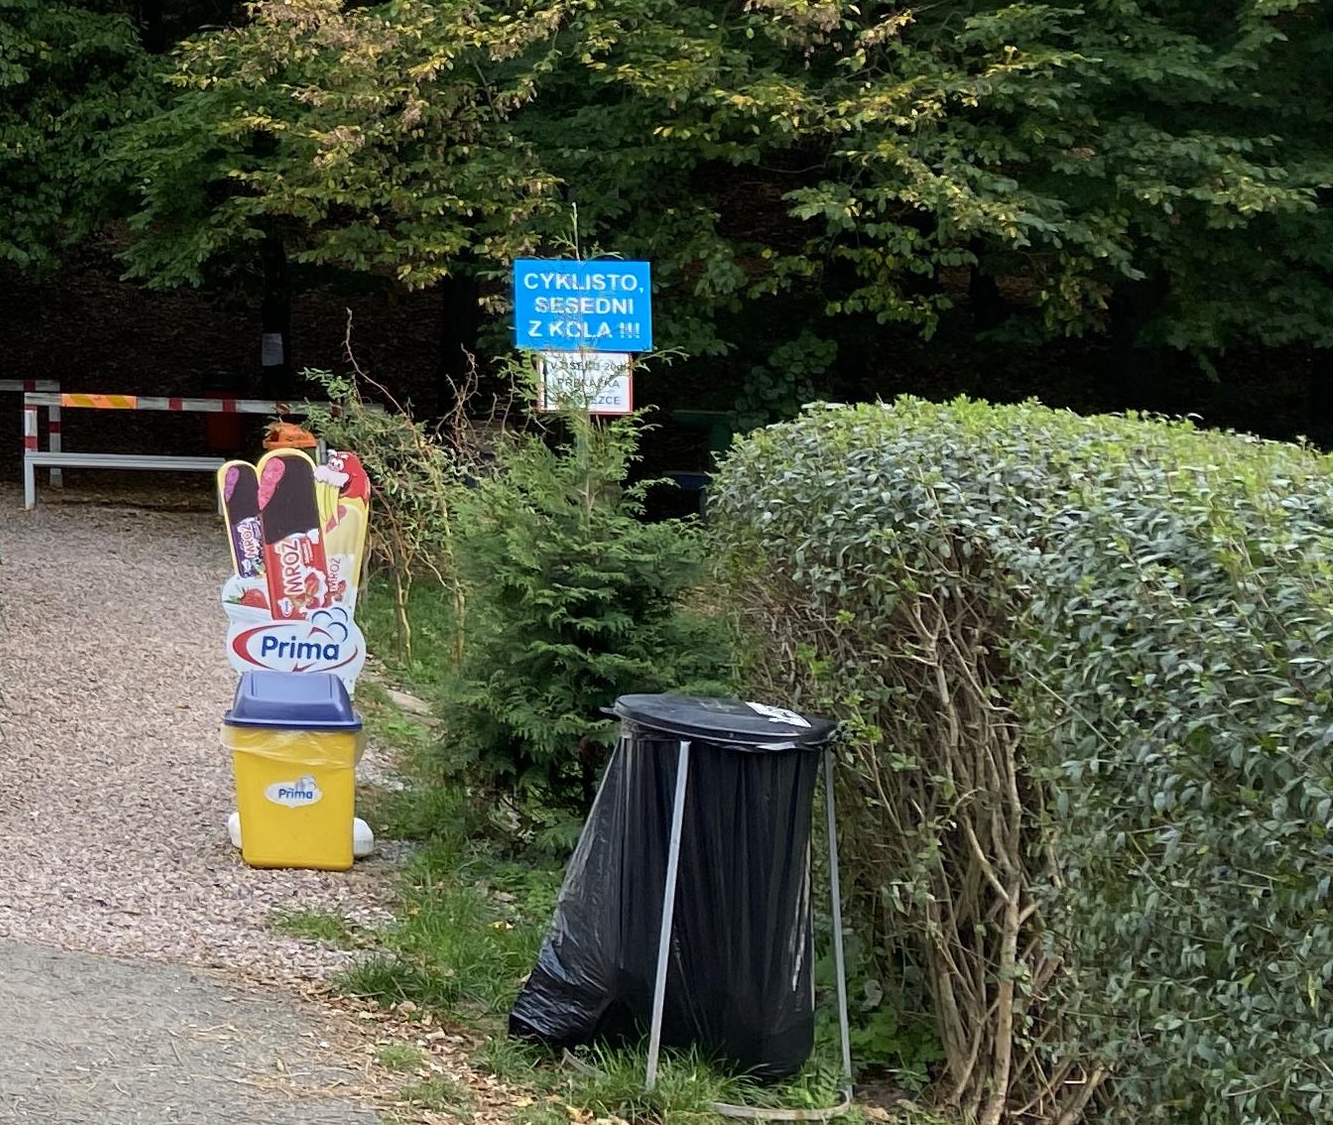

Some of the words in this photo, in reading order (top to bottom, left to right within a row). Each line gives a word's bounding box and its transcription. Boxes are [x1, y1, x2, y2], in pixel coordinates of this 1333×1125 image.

[524, 273, 644, 294] CYKLISTO,
[535, 297, 633, 315] SESEDNI
[527, 319, 543, 337] Z
[548, 320, 614, 338] KOLA
[619, 322, 641, 339] !!!
[261, 635, 341, 662] Prima
[278, 787, 314, 800] Prima
